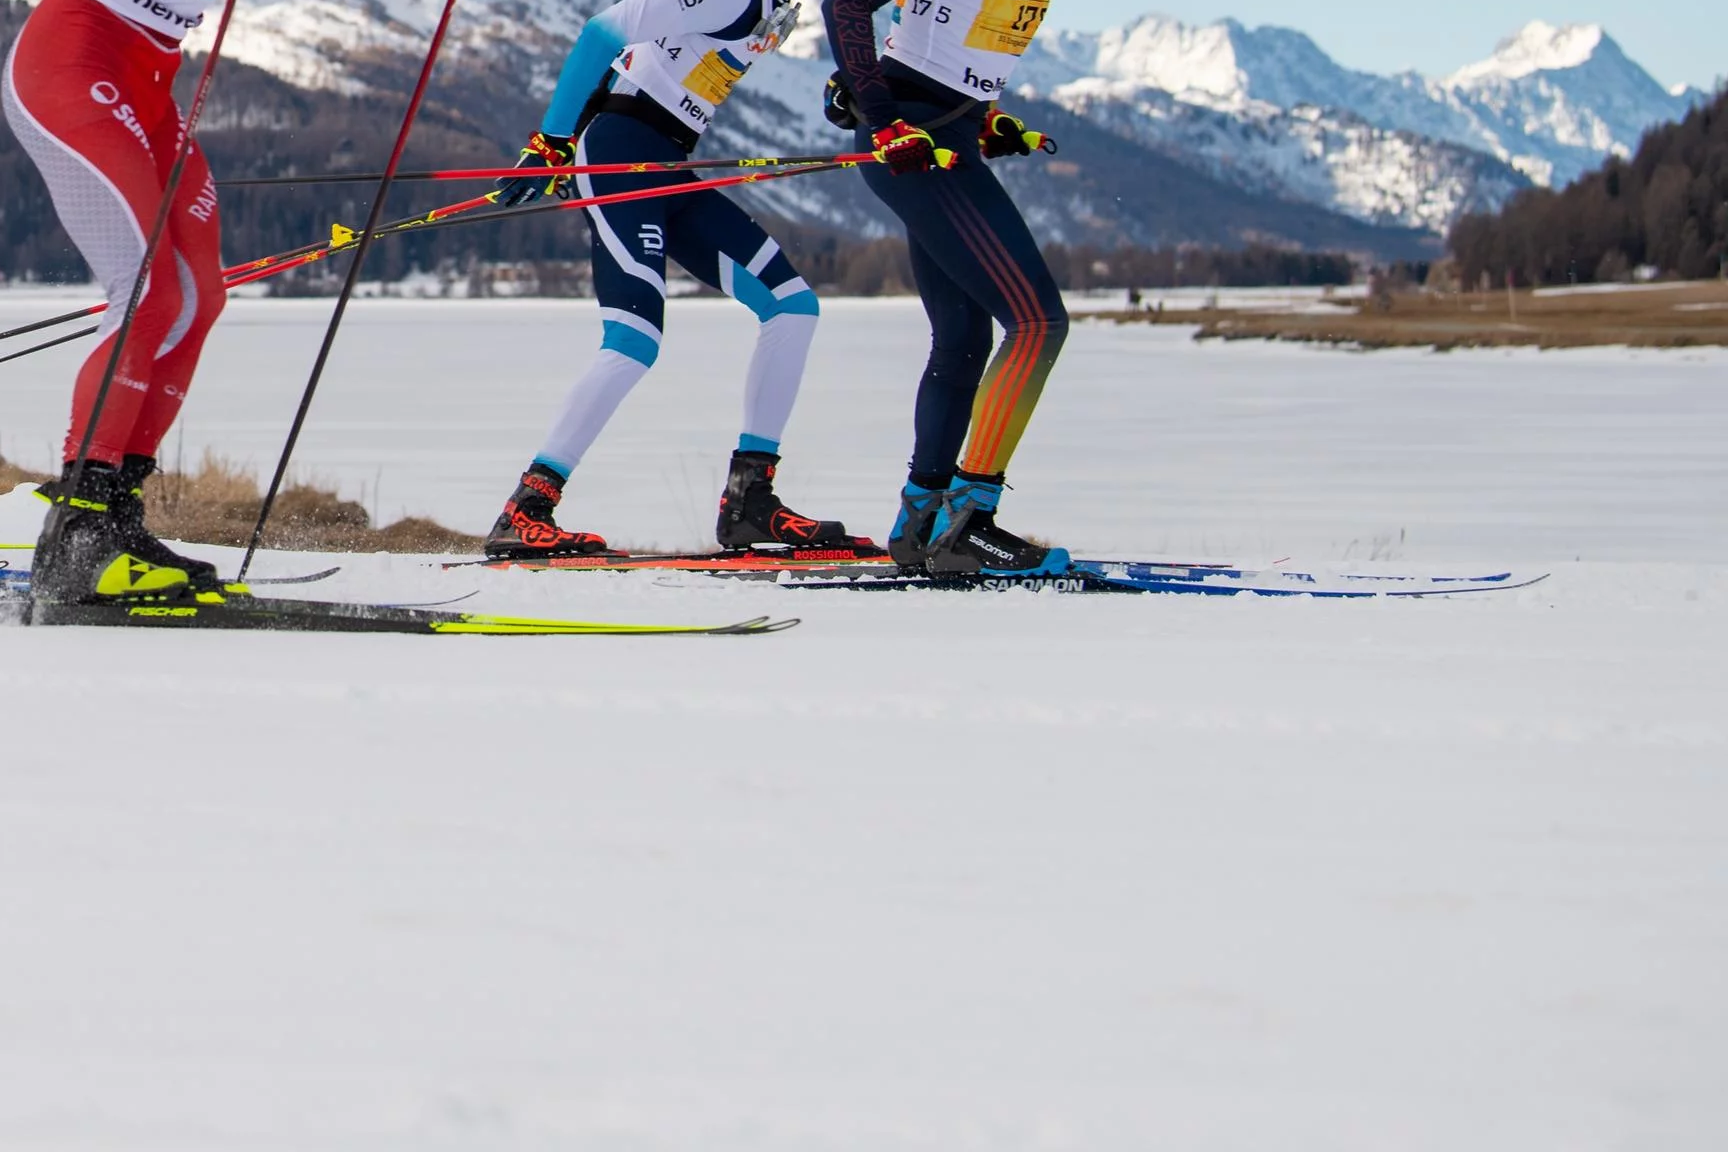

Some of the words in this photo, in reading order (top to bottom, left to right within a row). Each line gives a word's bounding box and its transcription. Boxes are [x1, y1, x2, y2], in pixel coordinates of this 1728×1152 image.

[737, 157, 779, 167] LEKI
[793, 550, 858, 560] ROSSIGNOL
[549, 557, 609, 567] ROSSIGNOL
[982, 578, 1085, 592] SALOMON
[129, 607, 198, 617] FISCHER
